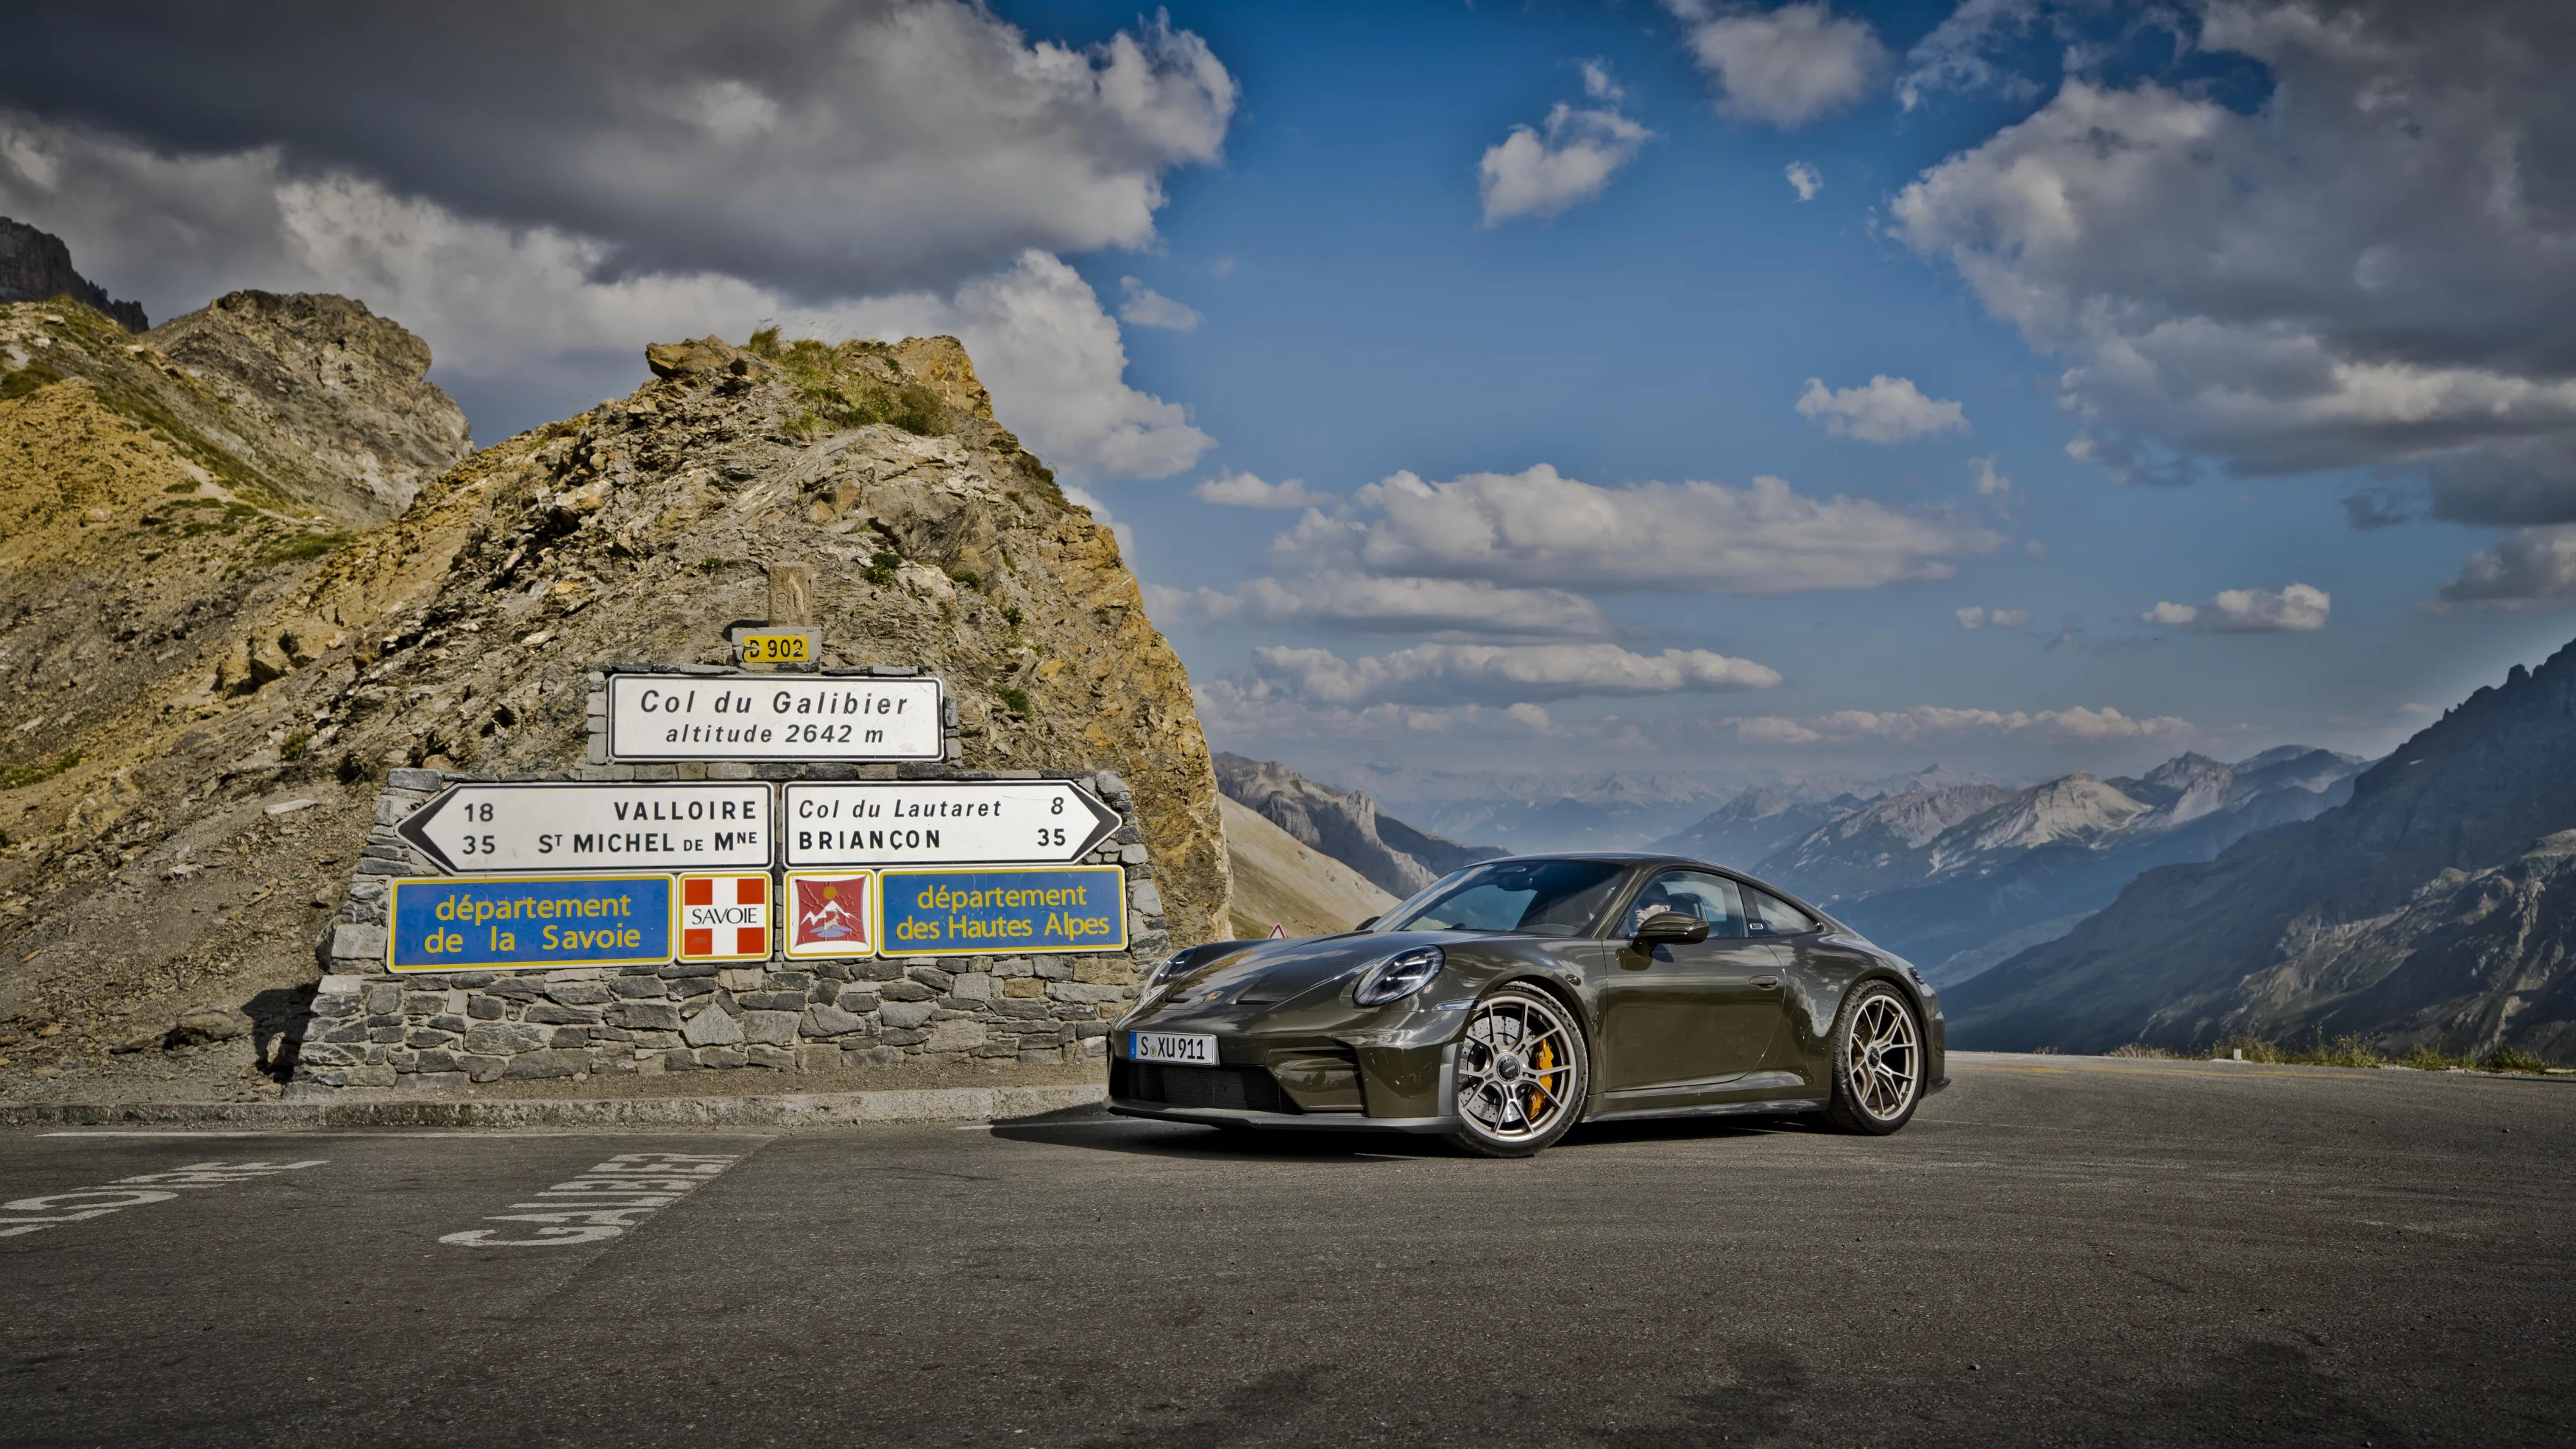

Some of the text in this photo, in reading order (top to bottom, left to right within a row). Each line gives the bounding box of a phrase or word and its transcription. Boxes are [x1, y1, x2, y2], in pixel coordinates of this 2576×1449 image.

[749, 639, 804, 658] D 902
[640, 690, 907, 715] Col du Galibier
[665, 723, 883, 743] altitude 2642 m
[464, 801, 756, 823] 18 VALLOIRE
[799, 796, 1064, 818] Col du Lautaret 8
[462, 835, 495, 855] 35
[573, 832, 675, 854] MICHEL
[683, 839, 704, 851] DE
[799, 828, 1066, 850] BRIANÇON 35
[436, 894, 631, 924] département
[917, 885, 1087, 913] département
[692, 907, 757, 924] SAVOIE
[896, 912, 1110, 941] des Hautes Alpes
[425, 922, 640, 953] de la Savoie
[1140, 1035, 1149, 1056] S
[1157, 1036, 1175, 1058] XU
[1178, 1038, 1205, 1060] 911
[438, 1152, 739, 1247] GALIBIER
